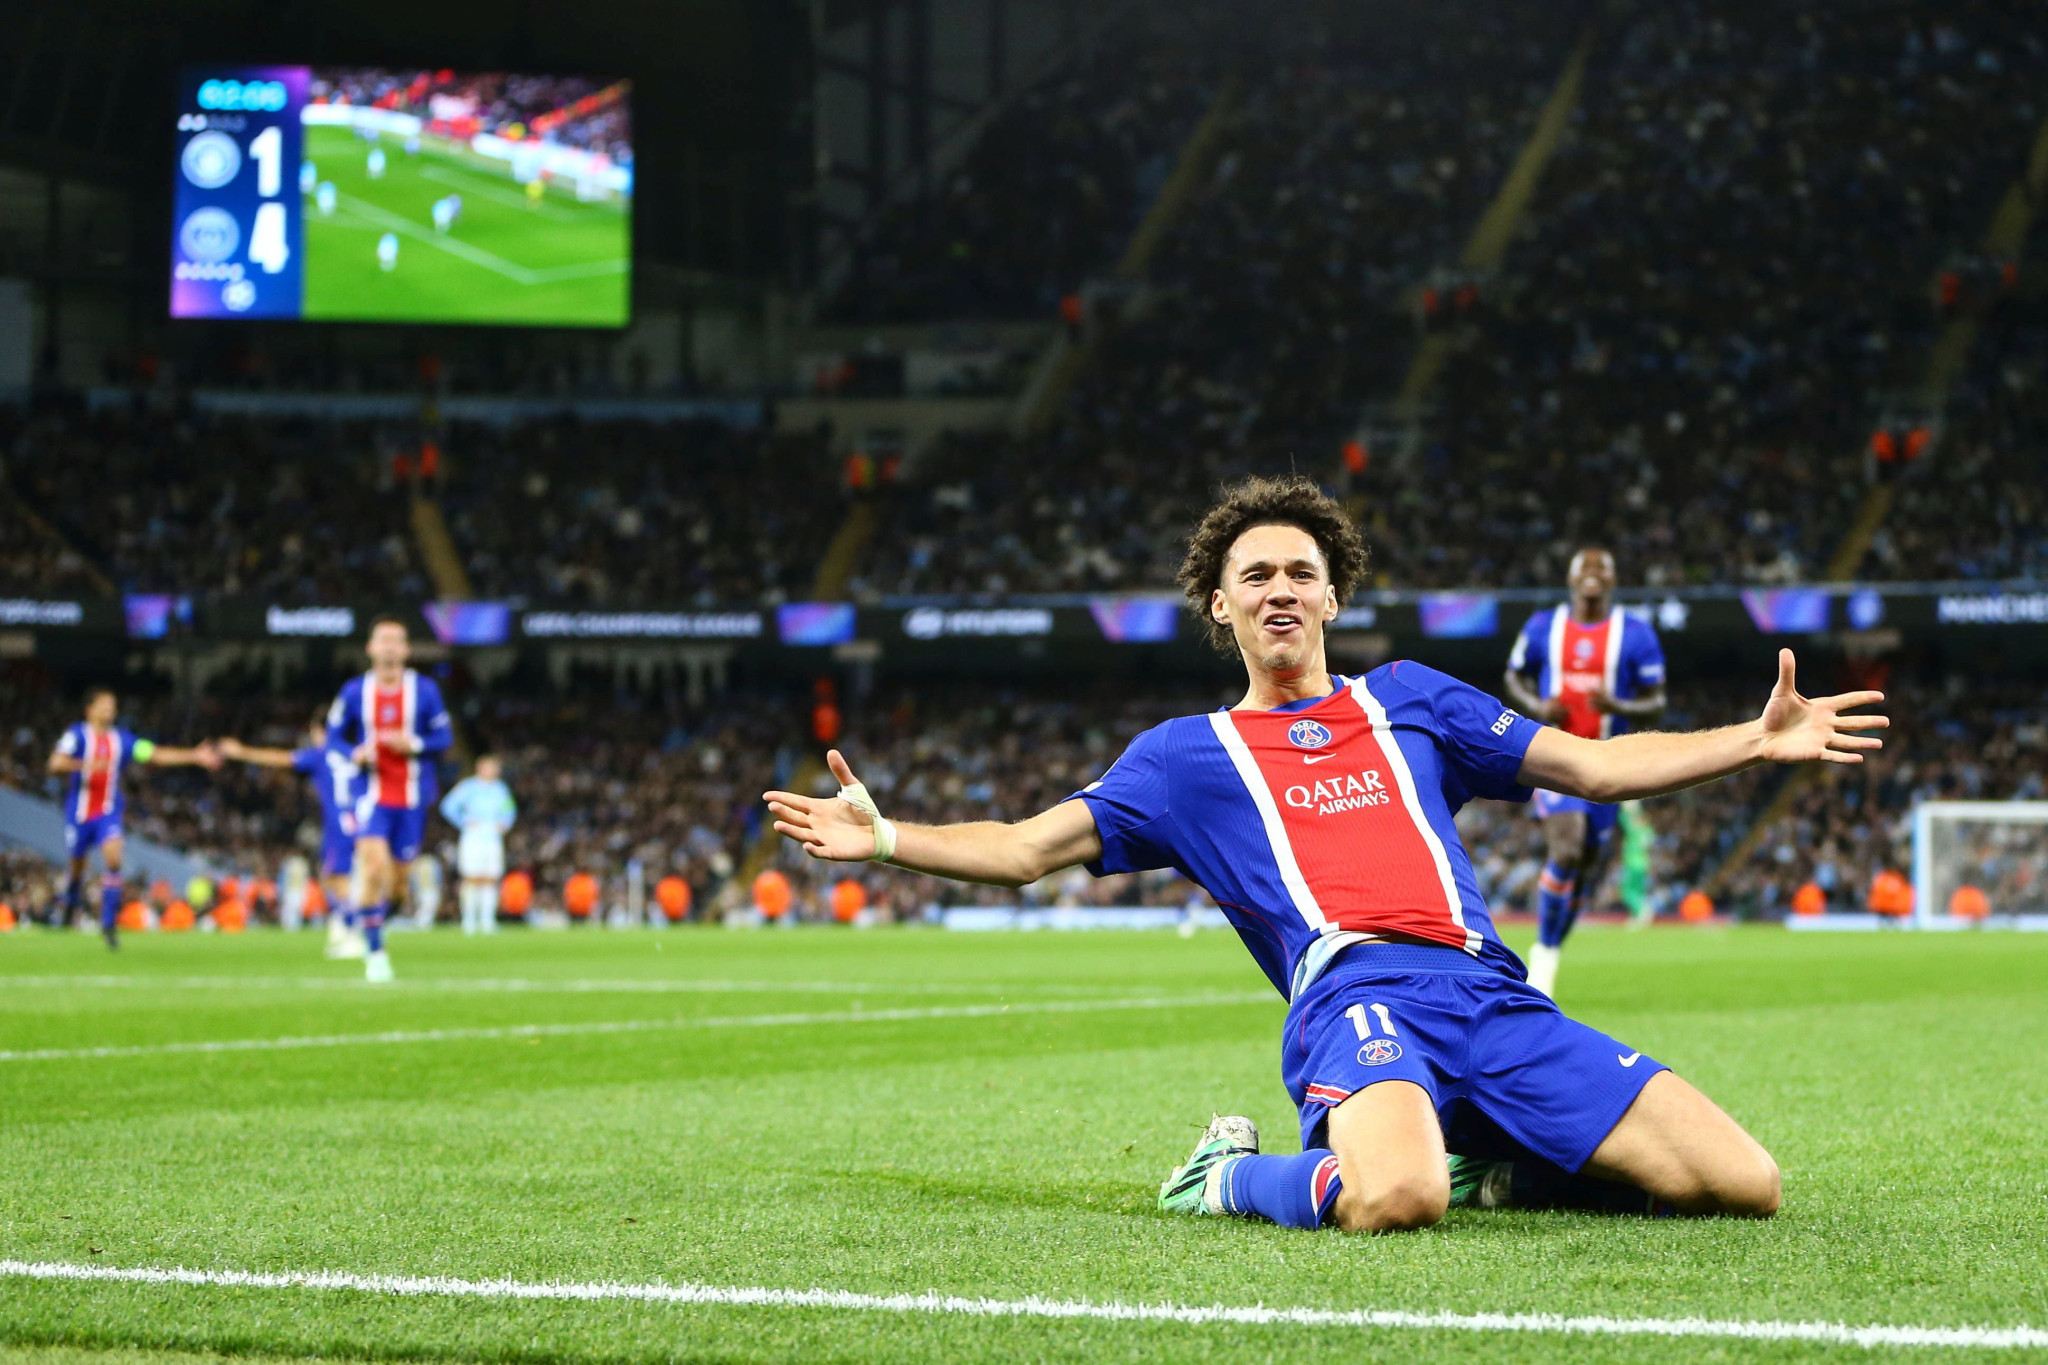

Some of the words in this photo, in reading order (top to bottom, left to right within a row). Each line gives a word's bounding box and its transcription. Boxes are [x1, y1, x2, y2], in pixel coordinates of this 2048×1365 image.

[249, 126, 282, 197] 1
[248, 202, 289, 274] 4
[1293, 721, 1318, 732] PARIS
[1285, 770, 1386, 809] QATAR
[1319, 791, 1390, 816] AIRWAYS
[1344, 1003, 1398, 1041] 11
